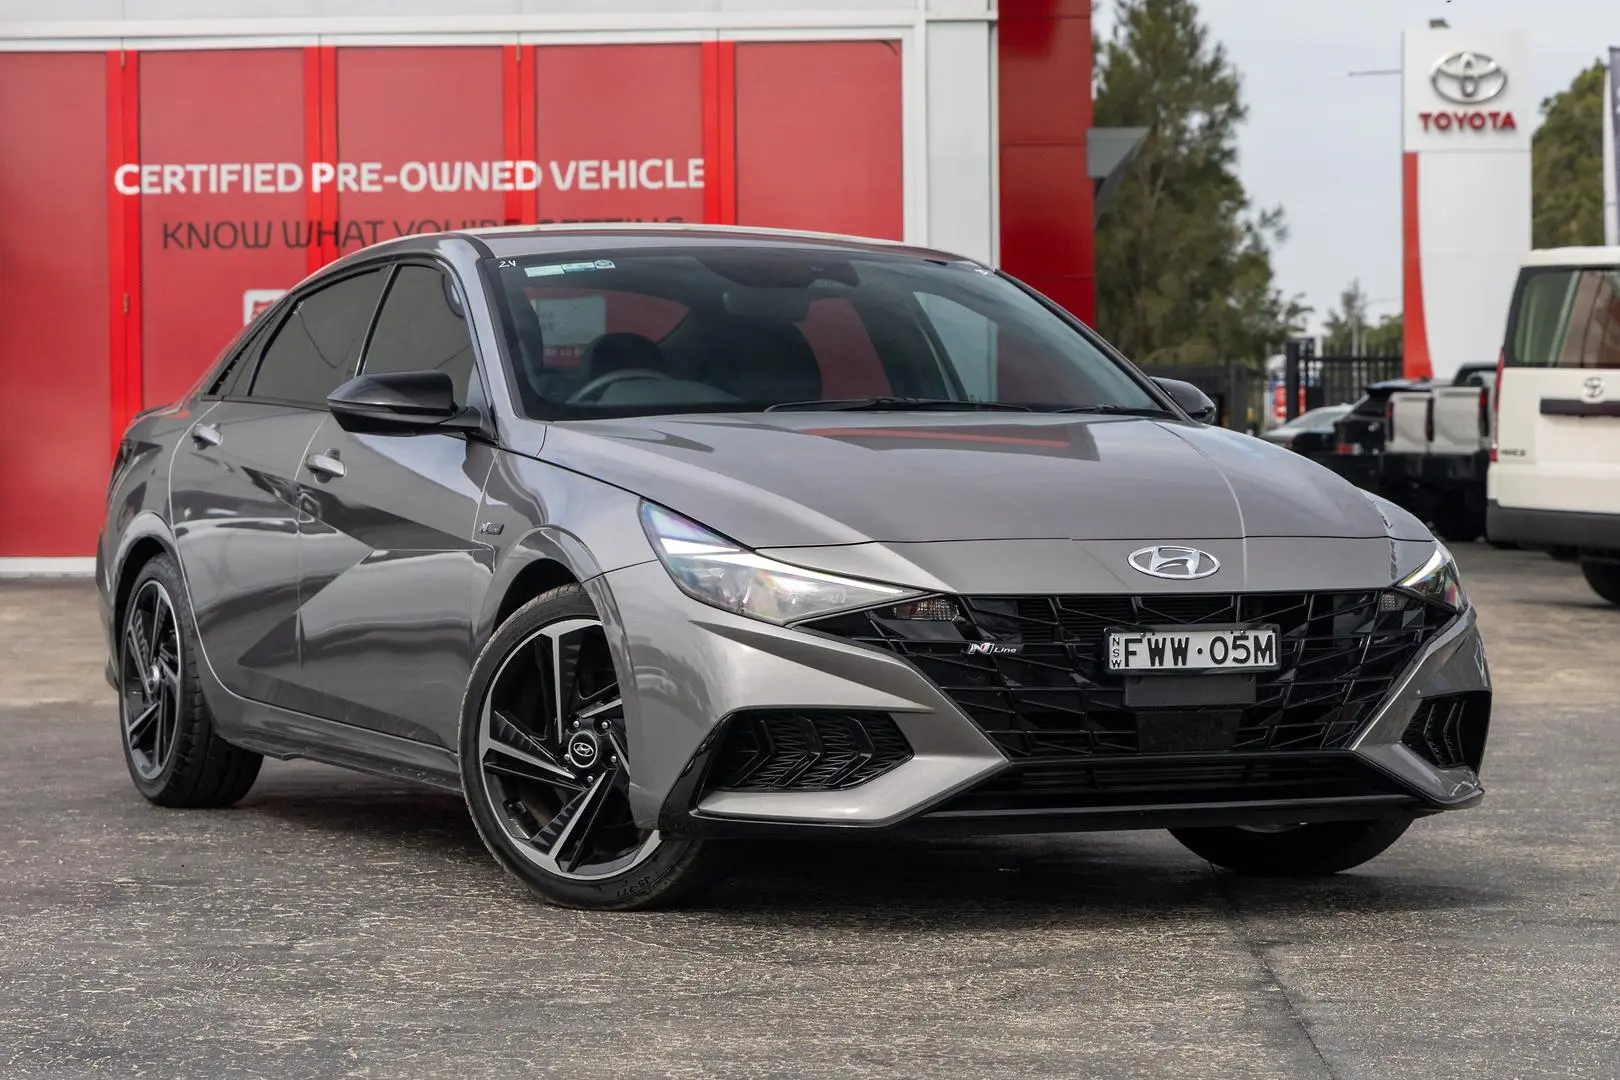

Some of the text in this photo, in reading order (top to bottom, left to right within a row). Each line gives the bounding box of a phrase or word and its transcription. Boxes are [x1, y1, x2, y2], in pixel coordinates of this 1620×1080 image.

[1418, 111, 1517, 132] TOYOTA
[114, 159, 704, 195] CERTIFIED PRE-OWNED VEHICLE
[162, 220, 273, 250] KNOW
[281, 219, 384, 248] WHAT
[993, 646, 1017, 654] Line
